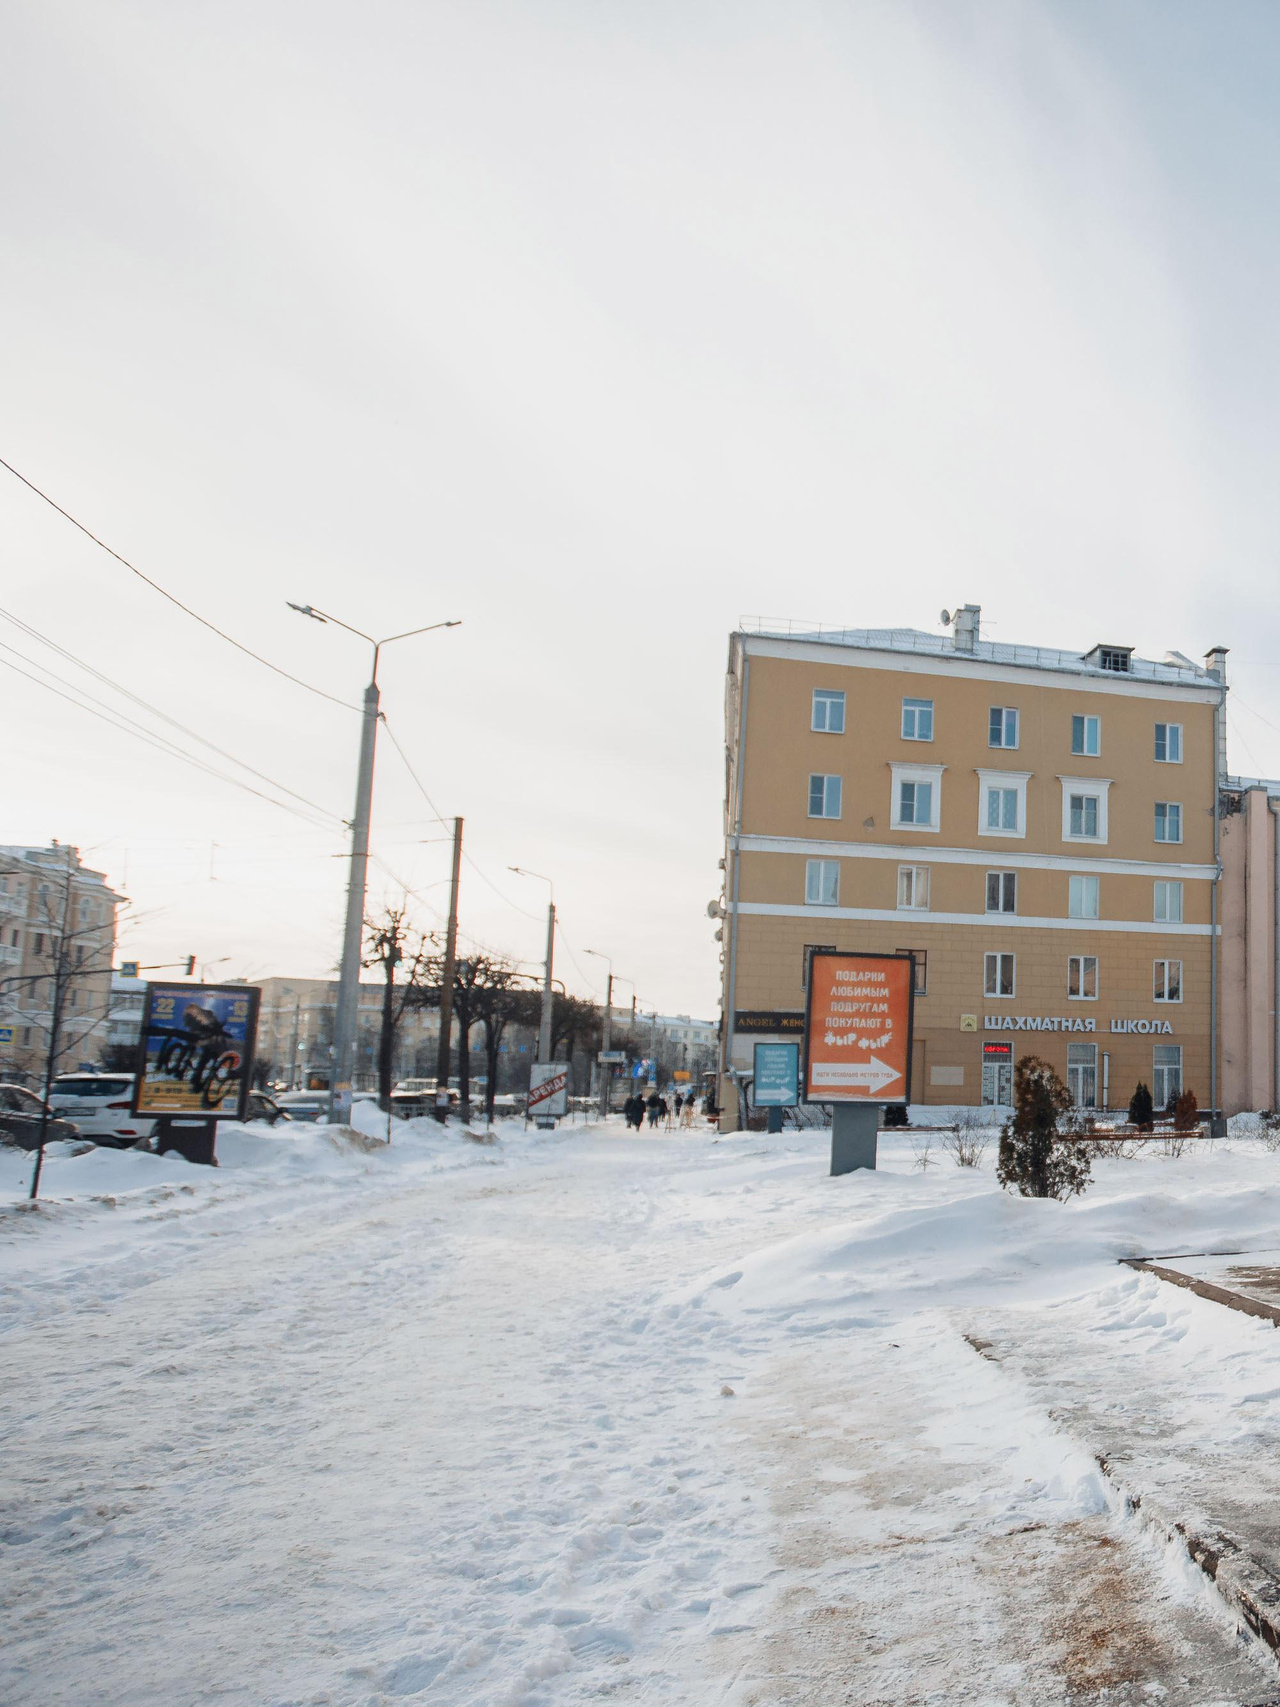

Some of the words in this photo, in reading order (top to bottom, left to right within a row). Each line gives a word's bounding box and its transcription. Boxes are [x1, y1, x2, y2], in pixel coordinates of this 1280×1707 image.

[830, 985, 890, 998] ЛЮБИМЫМ
[830, 1001, 889, 1013] ПОДРУГАМ
[885, 1018, 893, 1029] В
[984, 1015, 1096, 1033] ШАХМАТНАЯ
[1110, 1019, 1174, 1035] ШКОЛА
